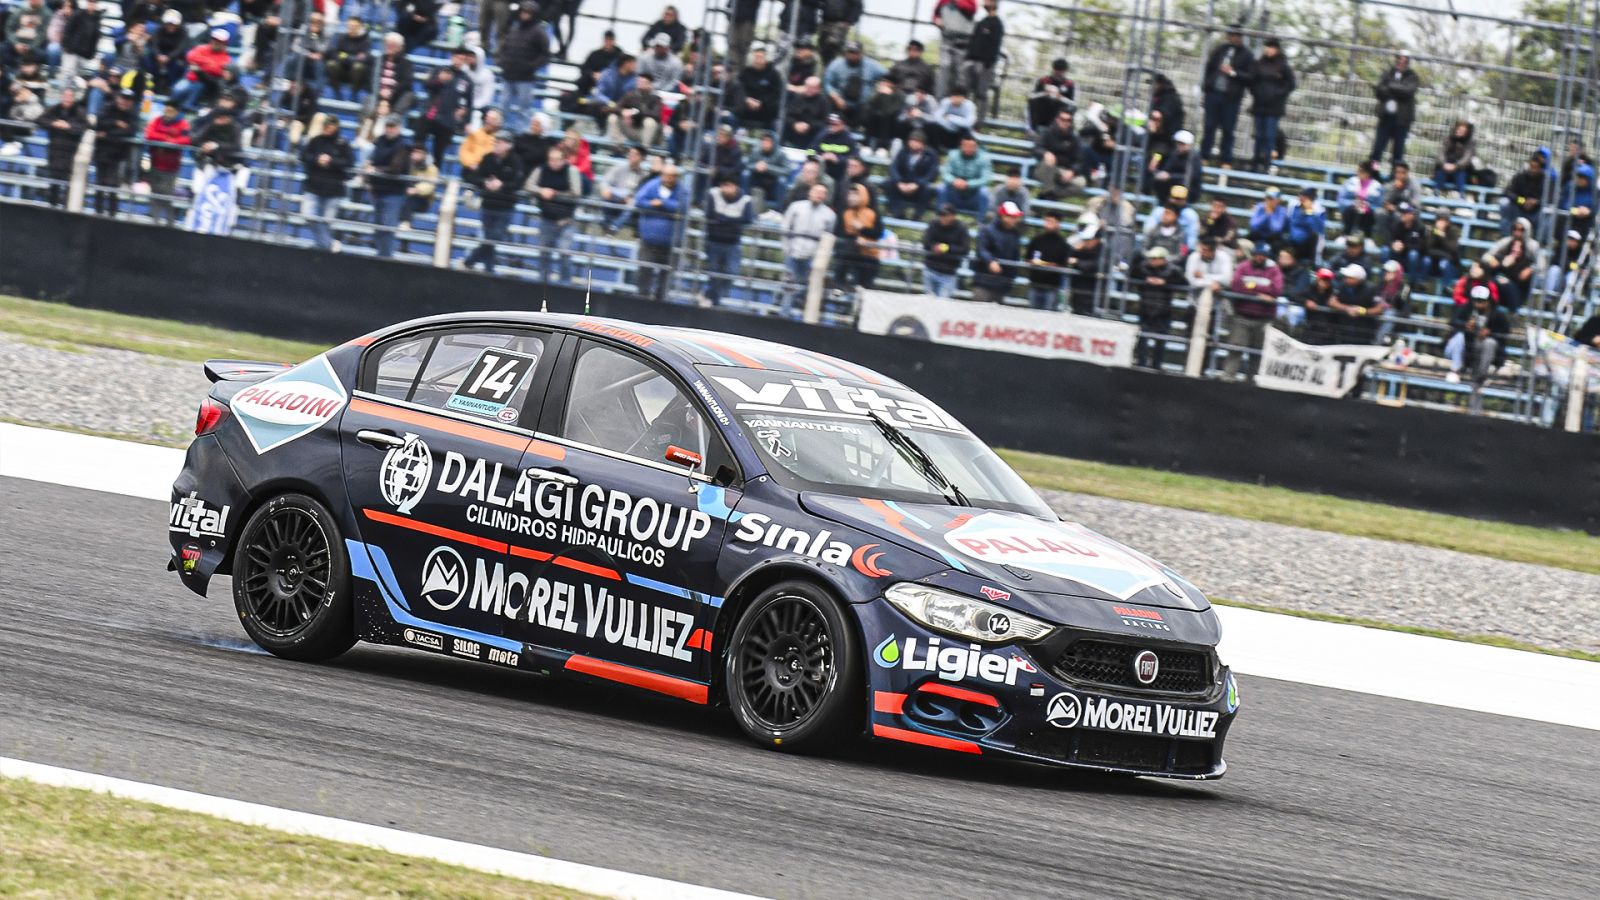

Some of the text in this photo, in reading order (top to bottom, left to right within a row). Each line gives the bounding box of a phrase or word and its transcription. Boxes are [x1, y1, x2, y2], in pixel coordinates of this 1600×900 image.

[982, 324, 1048, 348] AMICOS
[1053, 333, 1083, 353] DEL
[467, 354, 520, 399] 14
[235, 387, 341, 418] PALADINI
[743, 419, 863, 435] YANNANTUONI
[437, 451, 712, 551] DALAGI GROUP
[466, 504, 665, 568] CILINDROS HIDRAULICOS
[469, 557, 696, 662] MOREL VULLIEZ
[991, 617, 1009, 631] 14
[415, 633, 440, 646] TACSA
[1122, 619, 1170, 632] RACING
[488, 648, 519, 667] mota
[902, 637, 1018, 686] Ligier
[1141, 661, 1155, 675] FIAT
[1082, 697, 1219, 738] MOREL VULLIEZ
